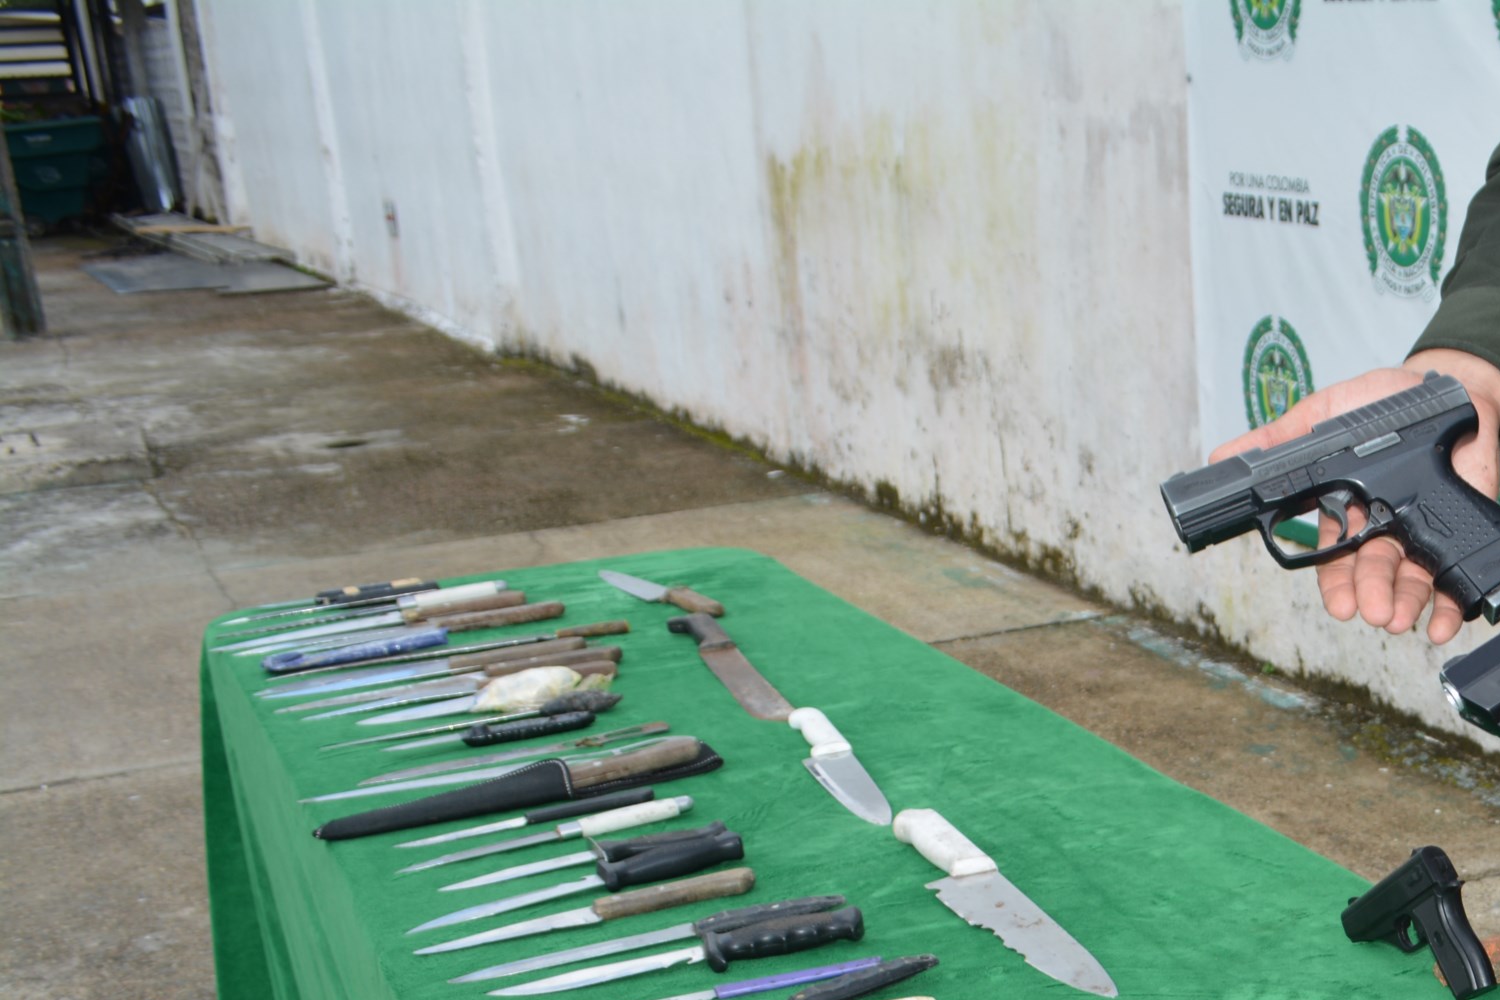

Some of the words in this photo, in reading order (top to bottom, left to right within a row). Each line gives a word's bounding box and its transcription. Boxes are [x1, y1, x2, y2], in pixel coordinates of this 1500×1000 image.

[1228, 171, 1244, 187] POR
[1247, 174, 1265, 189] UNA
[1266, 175, 1309, 193] COLOMBIA
[1222, 191, 1264, 219] SEGURA
[1267, 196, 1275, 221] Y
[1278, 197, 1293, 223] EN
[1296, 200, 1319, 226] PAZ
